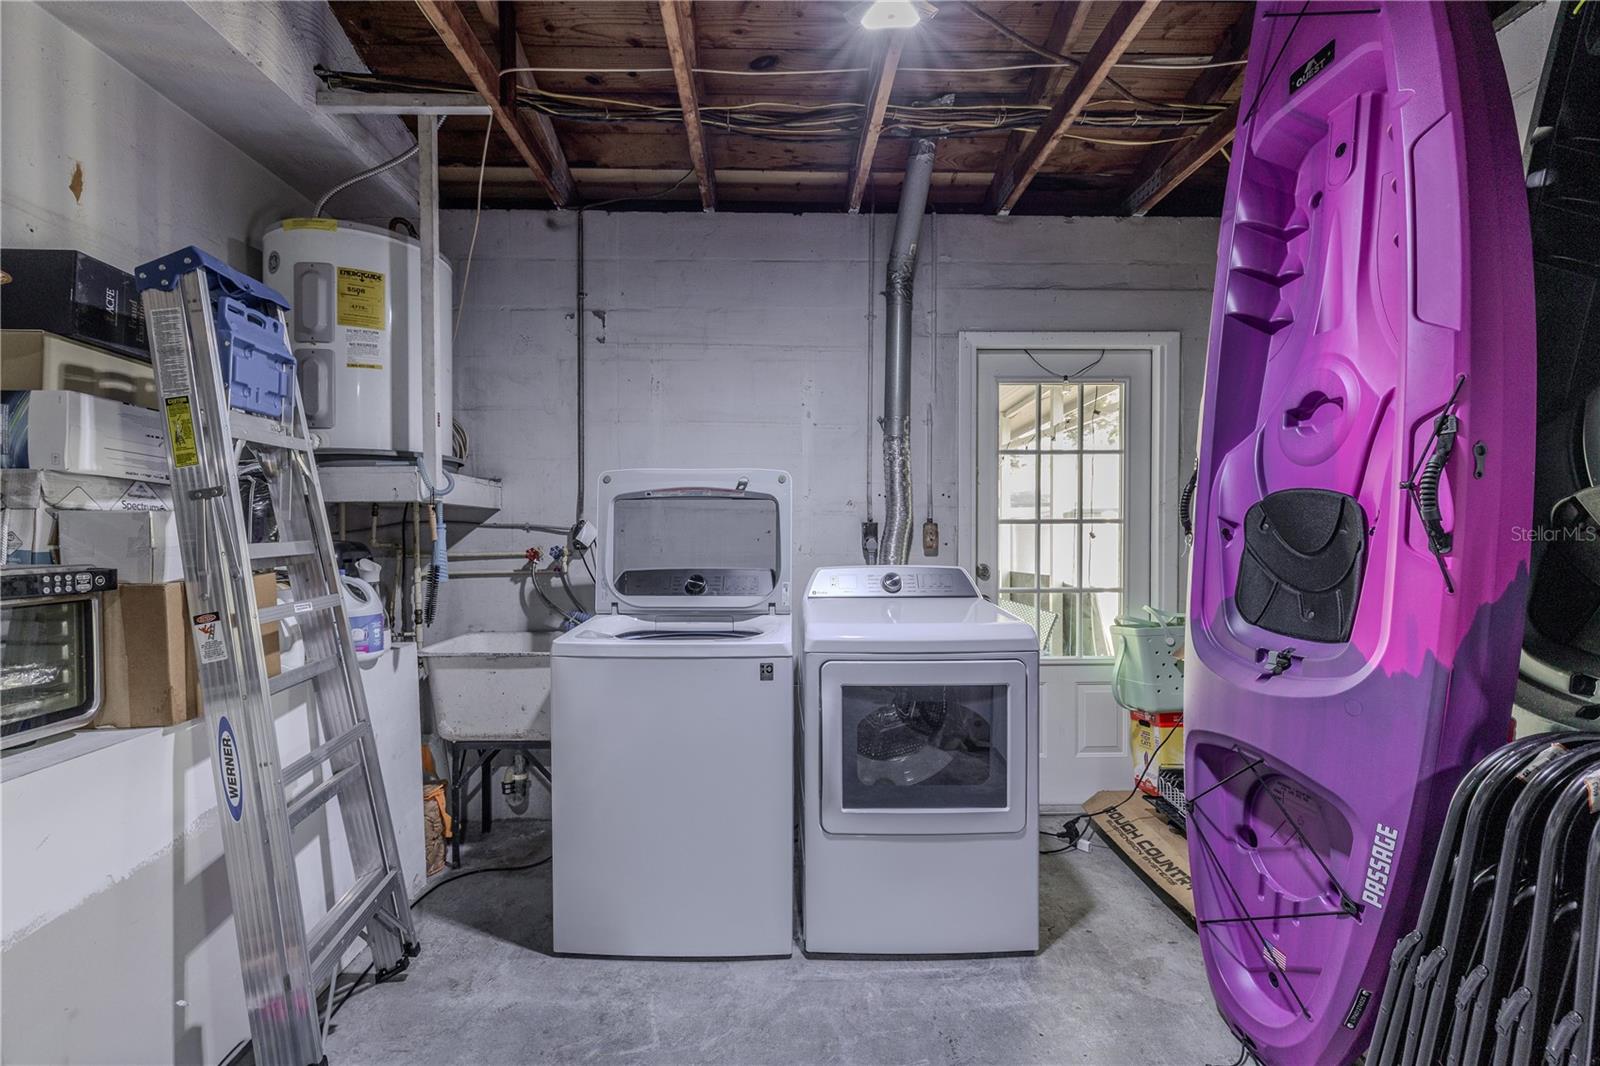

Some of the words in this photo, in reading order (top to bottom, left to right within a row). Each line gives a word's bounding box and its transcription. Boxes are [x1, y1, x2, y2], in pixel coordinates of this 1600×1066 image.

[1296, 58, 1326, 88] QUEST
[105, 287, 115, 315] ACFE
[121, 499, 159, 511] Spectrum
[223, 736, 239, 799] WERNER
[1362, 823, 1398, 909] PASSAGE
